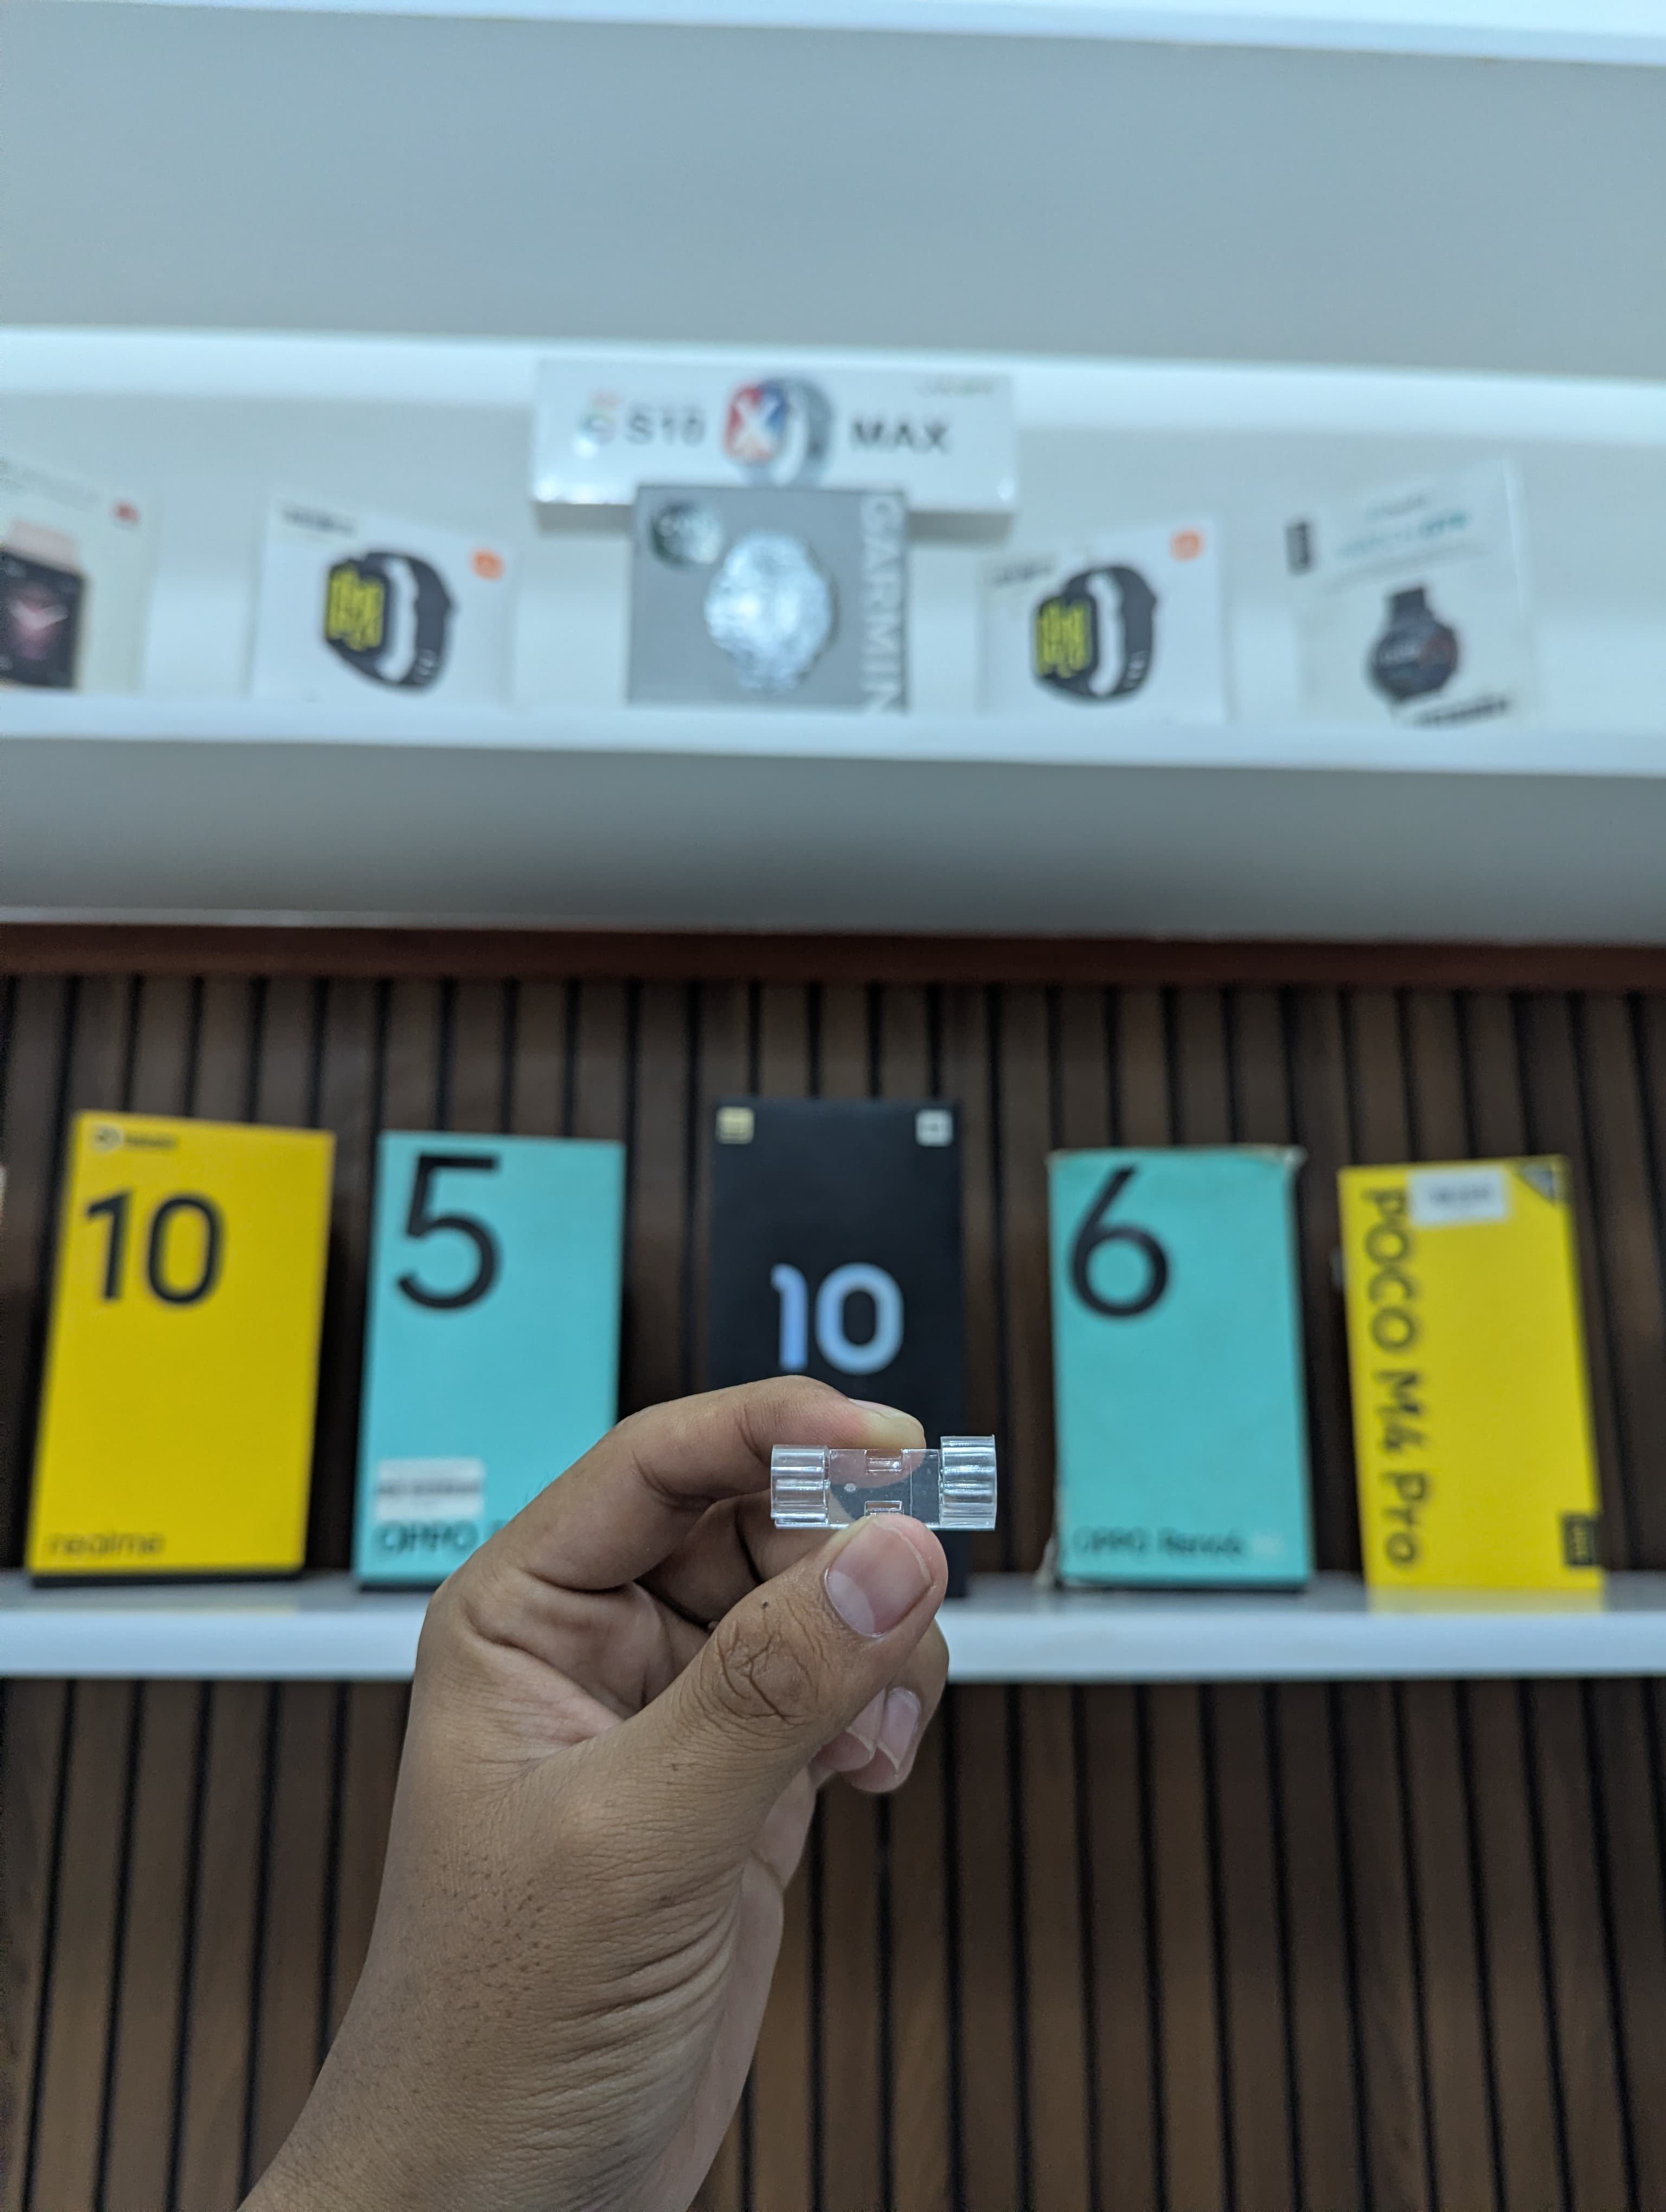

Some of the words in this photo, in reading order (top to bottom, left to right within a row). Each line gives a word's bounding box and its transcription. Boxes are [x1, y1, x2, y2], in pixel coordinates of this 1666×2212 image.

[849, 416, 951, 454] MAX
[860, 496, 904, 713] GARMIN
[85, 1191, 227, 1309] 10
[397, 1152, 502, 1312] 5
[1068, 1165, 1170, 1320] 6
[770, 1262, 905, 1375] 10
[1379, 1472, 1432, 1568] Pro
